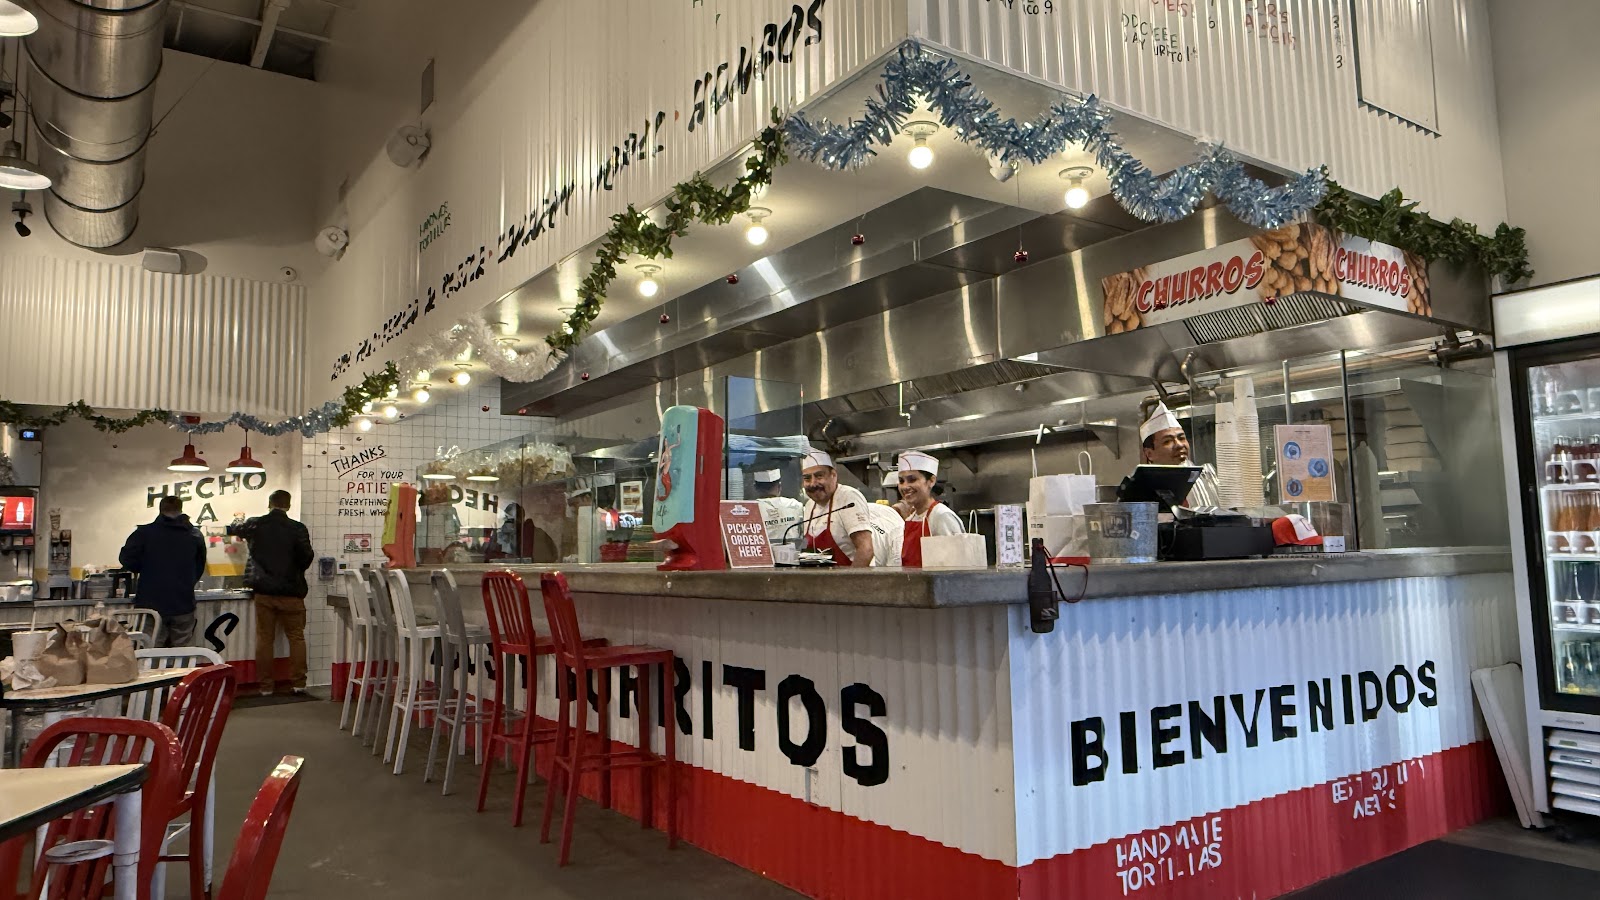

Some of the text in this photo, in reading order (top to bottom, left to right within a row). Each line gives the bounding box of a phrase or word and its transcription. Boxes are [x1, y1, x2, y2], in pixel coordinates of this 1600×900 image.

[1136, 250, 1265, 313] CHURROS
[1334, 247, 1411, 298] CHURROS
[331, 445, 385, 473] THANKS
[357, 471, 404, 480] FOR YOUR
[146, 472, 267, 508] HECHO
[346, 482, 388, 494] PATIE
[195, 502, 219, 525] A
[338, 508, 365, 517] FRESH
[726, 523, 762, 534] PICK-UP
[730, 535, 766, 545] ORDERS
[738, 546, 763, 558] HERE
[1070, 659, 1438, 787] BIENVENIDOS
[1116, 842, 1223, 897] TORTILAS
